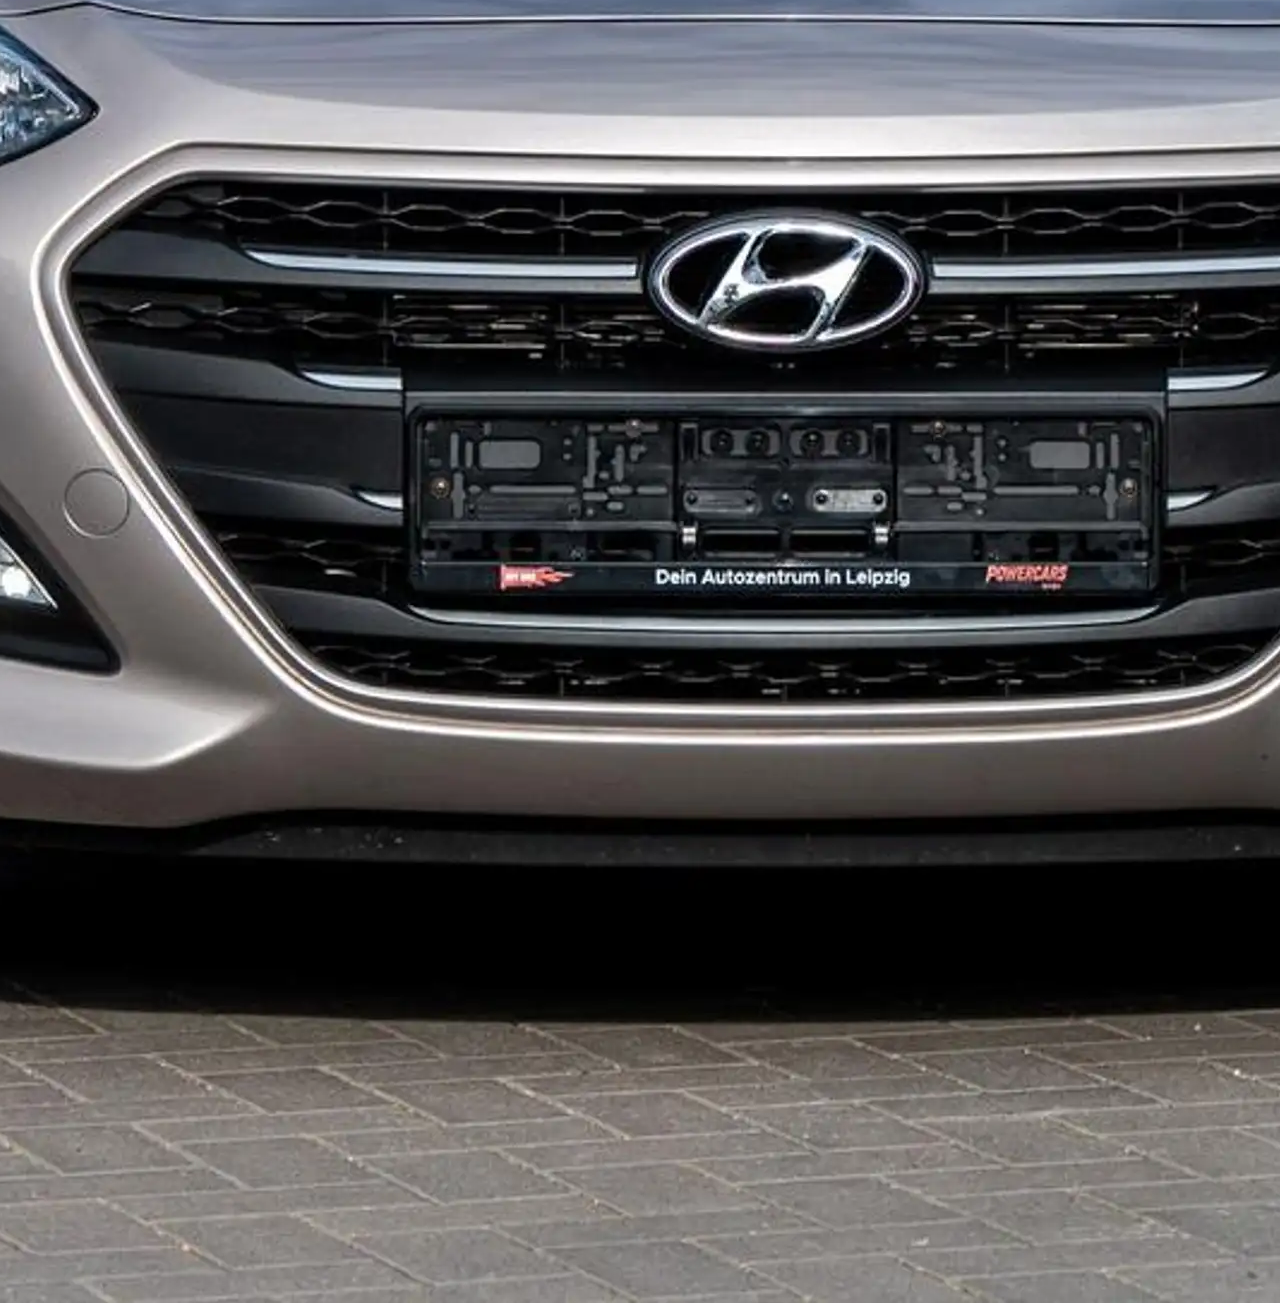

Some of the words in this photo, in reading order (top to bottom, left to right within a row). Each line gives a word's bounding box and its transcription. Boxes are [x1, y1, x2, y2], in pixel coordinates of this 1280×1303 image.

[655, 568, 697, 585] Dein
[701, 568, 820, 585] Autozentrum
[824, 568, 841, 585] in
[846, 568, 911, 589] Leipzig
[985, 564, 1069, 583] POWERCARS
